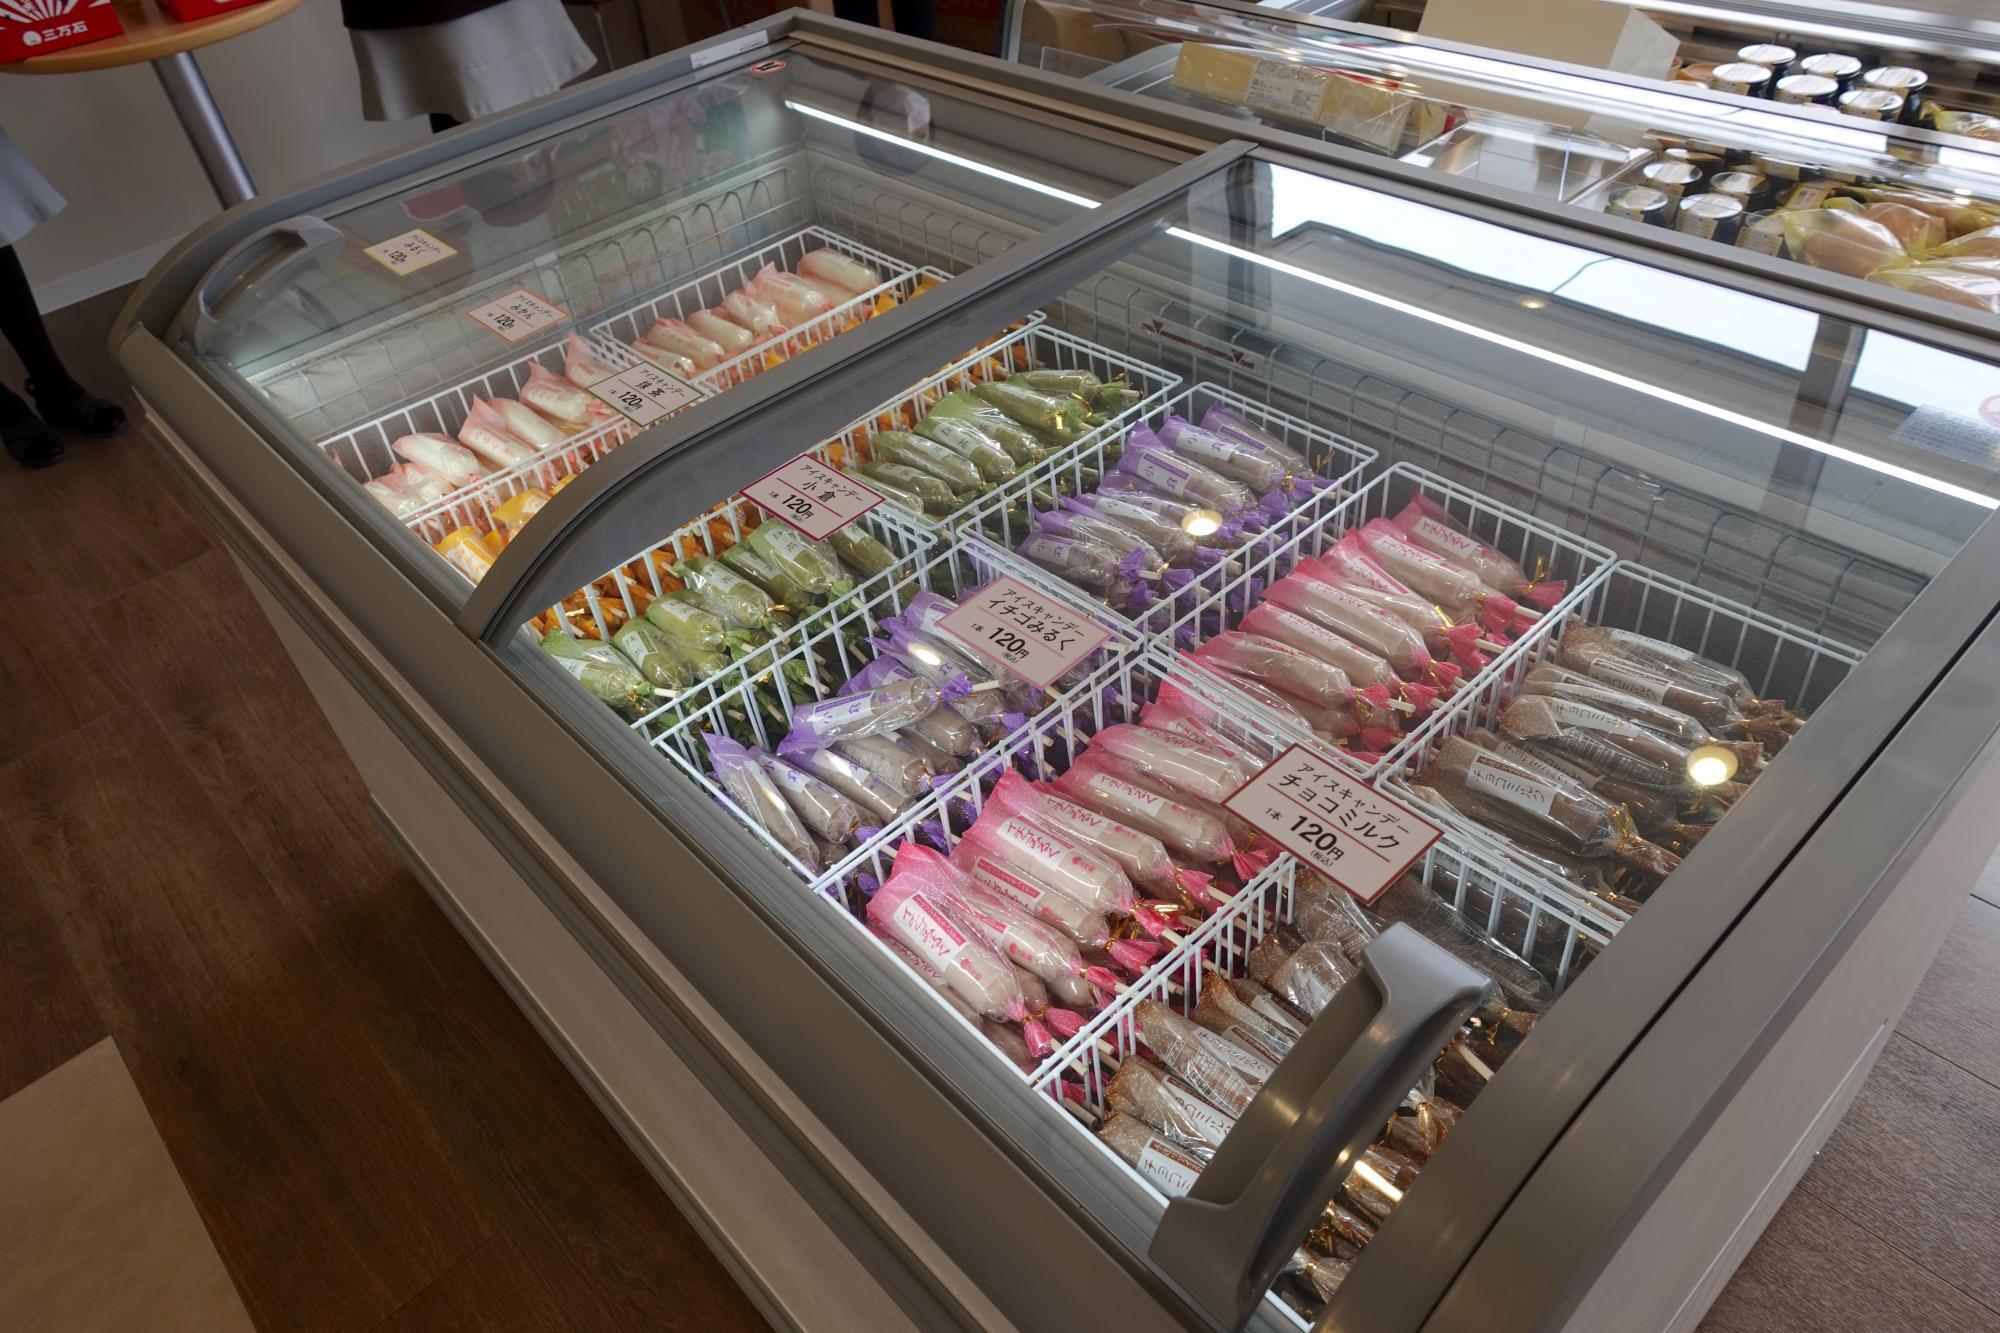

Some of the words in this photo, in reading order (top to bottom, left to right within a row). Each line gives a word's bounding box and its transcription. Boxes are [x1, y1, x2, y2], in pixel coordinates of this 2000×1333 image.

[41, 20, 89, 42] 三万石
[618, 391, 644, 411] 120円
[799, 464, 864, 502] アイスキャンデー
[802, 481, 837, 503] 小倉
[782, 494, 815, 521] 120円
[988, 599, 1076, 652] イチゴみるく
[1002, 588, 1085, 637] アイスキャンデー
[988, 627, 1030, 660] 120円
[1279, 773, 1400, 850] チョコミルク
[1296, 762, 1410, 834] アイスキャンデー
[1265, 807, 1283, 821] 1本
[1289, 815, 1345, 861] 120円
